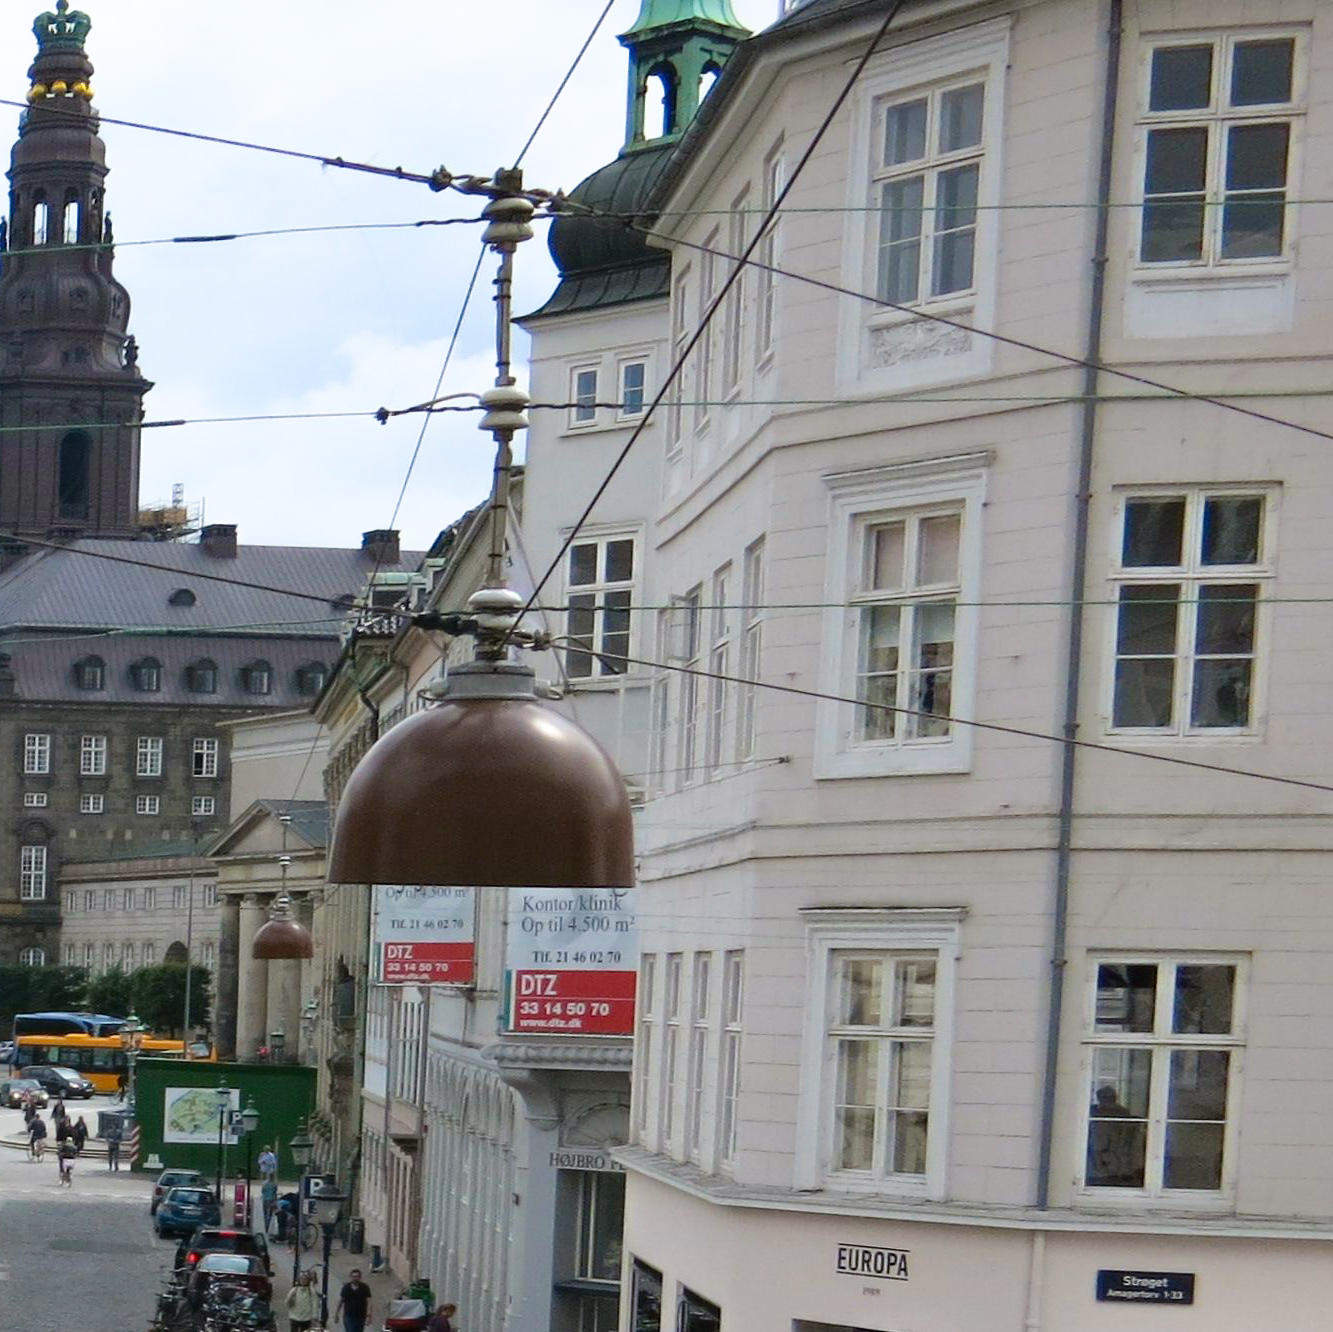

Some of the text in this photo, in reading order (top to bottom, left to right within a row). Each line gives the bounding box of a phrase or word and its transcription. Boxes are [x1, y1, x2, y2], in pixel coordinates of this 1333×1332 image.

[410, 919, 420, 929] 21
[424, 919, 435, 929] 46
[437, 919, 449, 929] 02
[452, 919, 464, 929] 70
[521, 916, 543, 936] Op
[548, 917, 563, 933] til
[567, 916, 610, 932] 4.500
[387, 944, 413, 959] DTZ
[532, 951, 621, 963] Tlf. 21 46 02 70
[387, 962, 449, 973] 33 14 50 70
[520, 974, 558, 996] DTZ
[520, 1002, 610, 1017] 33 14 50 70
[519, 1018, 582, 1029] www.dtz.dk
[549, 1152, 606, 1170] HØJBRO
[837, 1247, 909, 1277] EUROPA
[1123, 1276, 1168, 1288] Strøget
